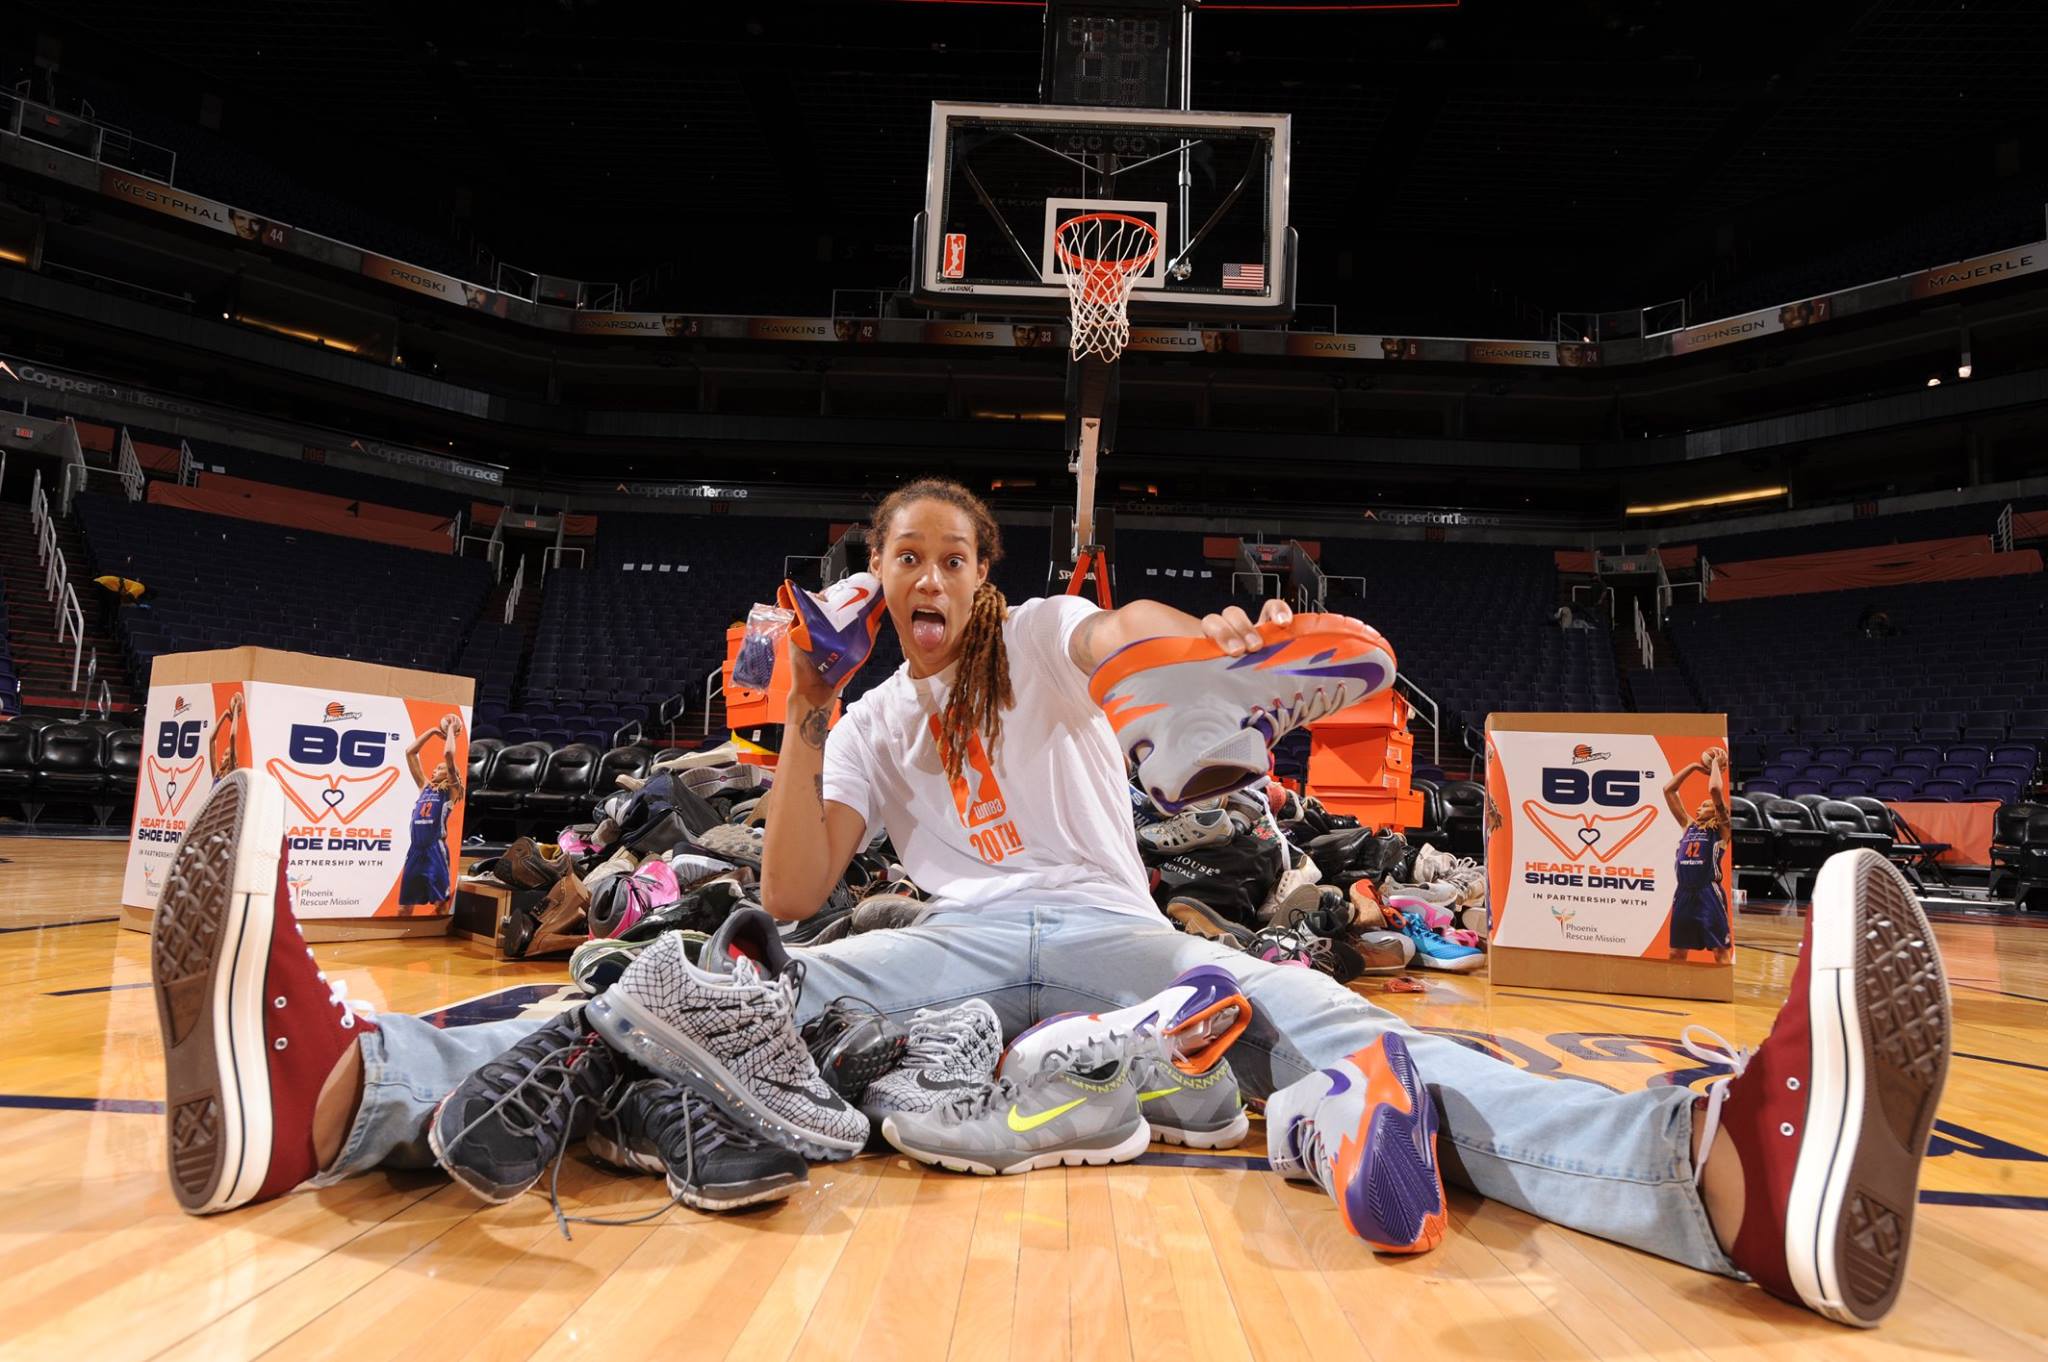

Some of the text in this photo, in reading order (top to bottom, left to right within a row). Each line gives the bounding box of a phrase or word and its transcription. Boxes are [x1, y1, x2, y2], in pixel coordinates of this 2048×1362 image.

[113, 179, 284, 243] WESTPHAL 44
[1928, 255, 2033, 289] MAJERLE
[390, 268, 446, 293] PROSKI
[603, 320, 661, 330] ARSDALE
[760, 323, 873, 338] HAWKINS 42
[1687, 303, 1826, 346] JOHNSON 7
[944, 330, 1052, 344] ADAMS 33
[1314, 341, 1357, 352] DAVIS
[1473, 346, 1598, 363] CHAMBERS 24
[141, 818, 165, 829] HEART
[138, 829, 163, 841] SHOE
[288, 826, 392, 838] ART & SOLE
[288, 838, 392, 851] OE DRIVE
[969, 820, 1024, 864] 20TH
[1685, 841, 1701, 858] 42
[1163, 862, 1197, 880] RENTALS
[1525, 861, 1655, 878] HEART & SOLE
[1525, 872, 1655, 891] SHOE DRIVE
[301, 888, 333, 897] Phoenix
[1547, 894, 1617, 904] PARTNERSHIP
[300, 898, 360, 906] Rescue Mission
[1566, 923, 1598, 933] Phoenix
[1566, 932, 1626, 943] Rescue Mission
